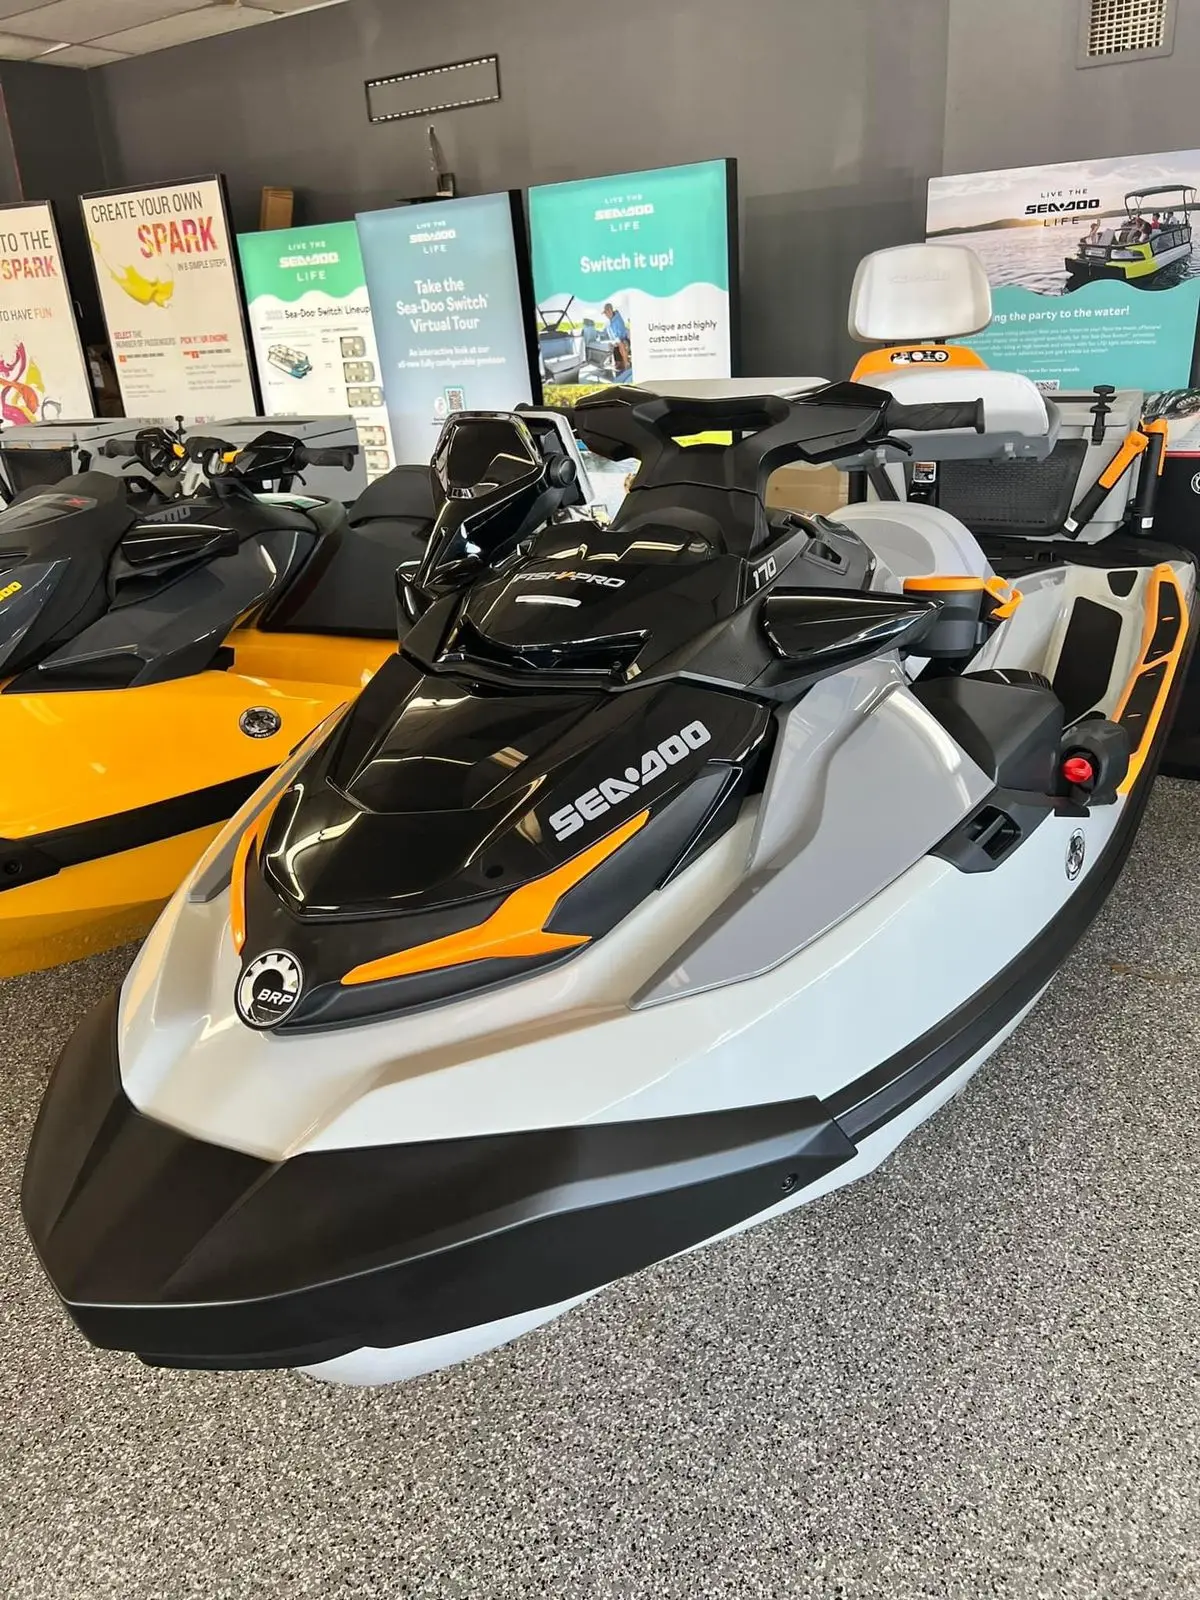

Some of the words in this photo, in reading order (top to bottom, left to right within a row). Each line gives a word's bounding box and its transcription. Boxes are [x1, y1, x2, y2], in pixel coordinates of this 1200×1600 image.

[604, 196, 623, 204] LIVE
[626, 193, 643, 202] THE
[1068, 188, 1088, 196] THE
[91, 200, 137, 223] CREATE
[137, 196, 171, 216] YOUR
[173, 191, 203, 212] OWN
[609, 221, 640, 232] LIFE
[1043, 216, 1079, 227] LIFE
[0, 233, 18, 253] TO
[20, 230, 52, 251] THE
[137, 216, 218, 259] SPARK
[288, 242, 307, 251] LIVE
[309, 240, 326, 249] THE
[422, 244, 448, 254] LIFE
[1, 255, 58, 280] SPARK
[188, 260, 209, 270] SIMPLE
[209, 258, 228, 268] STEPS
[580, 253, 631, 273] Switch
[634, 252, 647, 268] it
[649, 248, 673, 271] up!
[296, 270, 327, 282] LIFE
[414, 280, 442, 296] Take
[443, 277, 465, 292] the
[0, 310, 10, 321] TO
[10, 308, 34, 321] HAVE
[34, 307, 52, 319] FUN
[284, 308, 316, 319] Sea-Doo
[344, 305, 372, 316] Lineup
[396, 299, 445, 316] Sea-Doo
[1009, 311, 1027, 322] the
[1028, 309, 1057, 323] party
[1059, 309, 1072, 319] to
[1073, 307, 1092, 318] the
[1094, 305, 1130, 317] water!
[410, 316, 451, 334] Virtual
[453, 315, 481, 330] Tour
[648, 321, 675, 333] Unique
[677, 321, 692, 330] and
[693, 319, 717, 331] highly
[114, 331, 132, 339] SELECT
[209, 333, 229, 343] ENGINE
[649, 333, 700, 344] customizable
[752, 557, 777, 590] 170
[256, 988, 294, 1006] BRP
